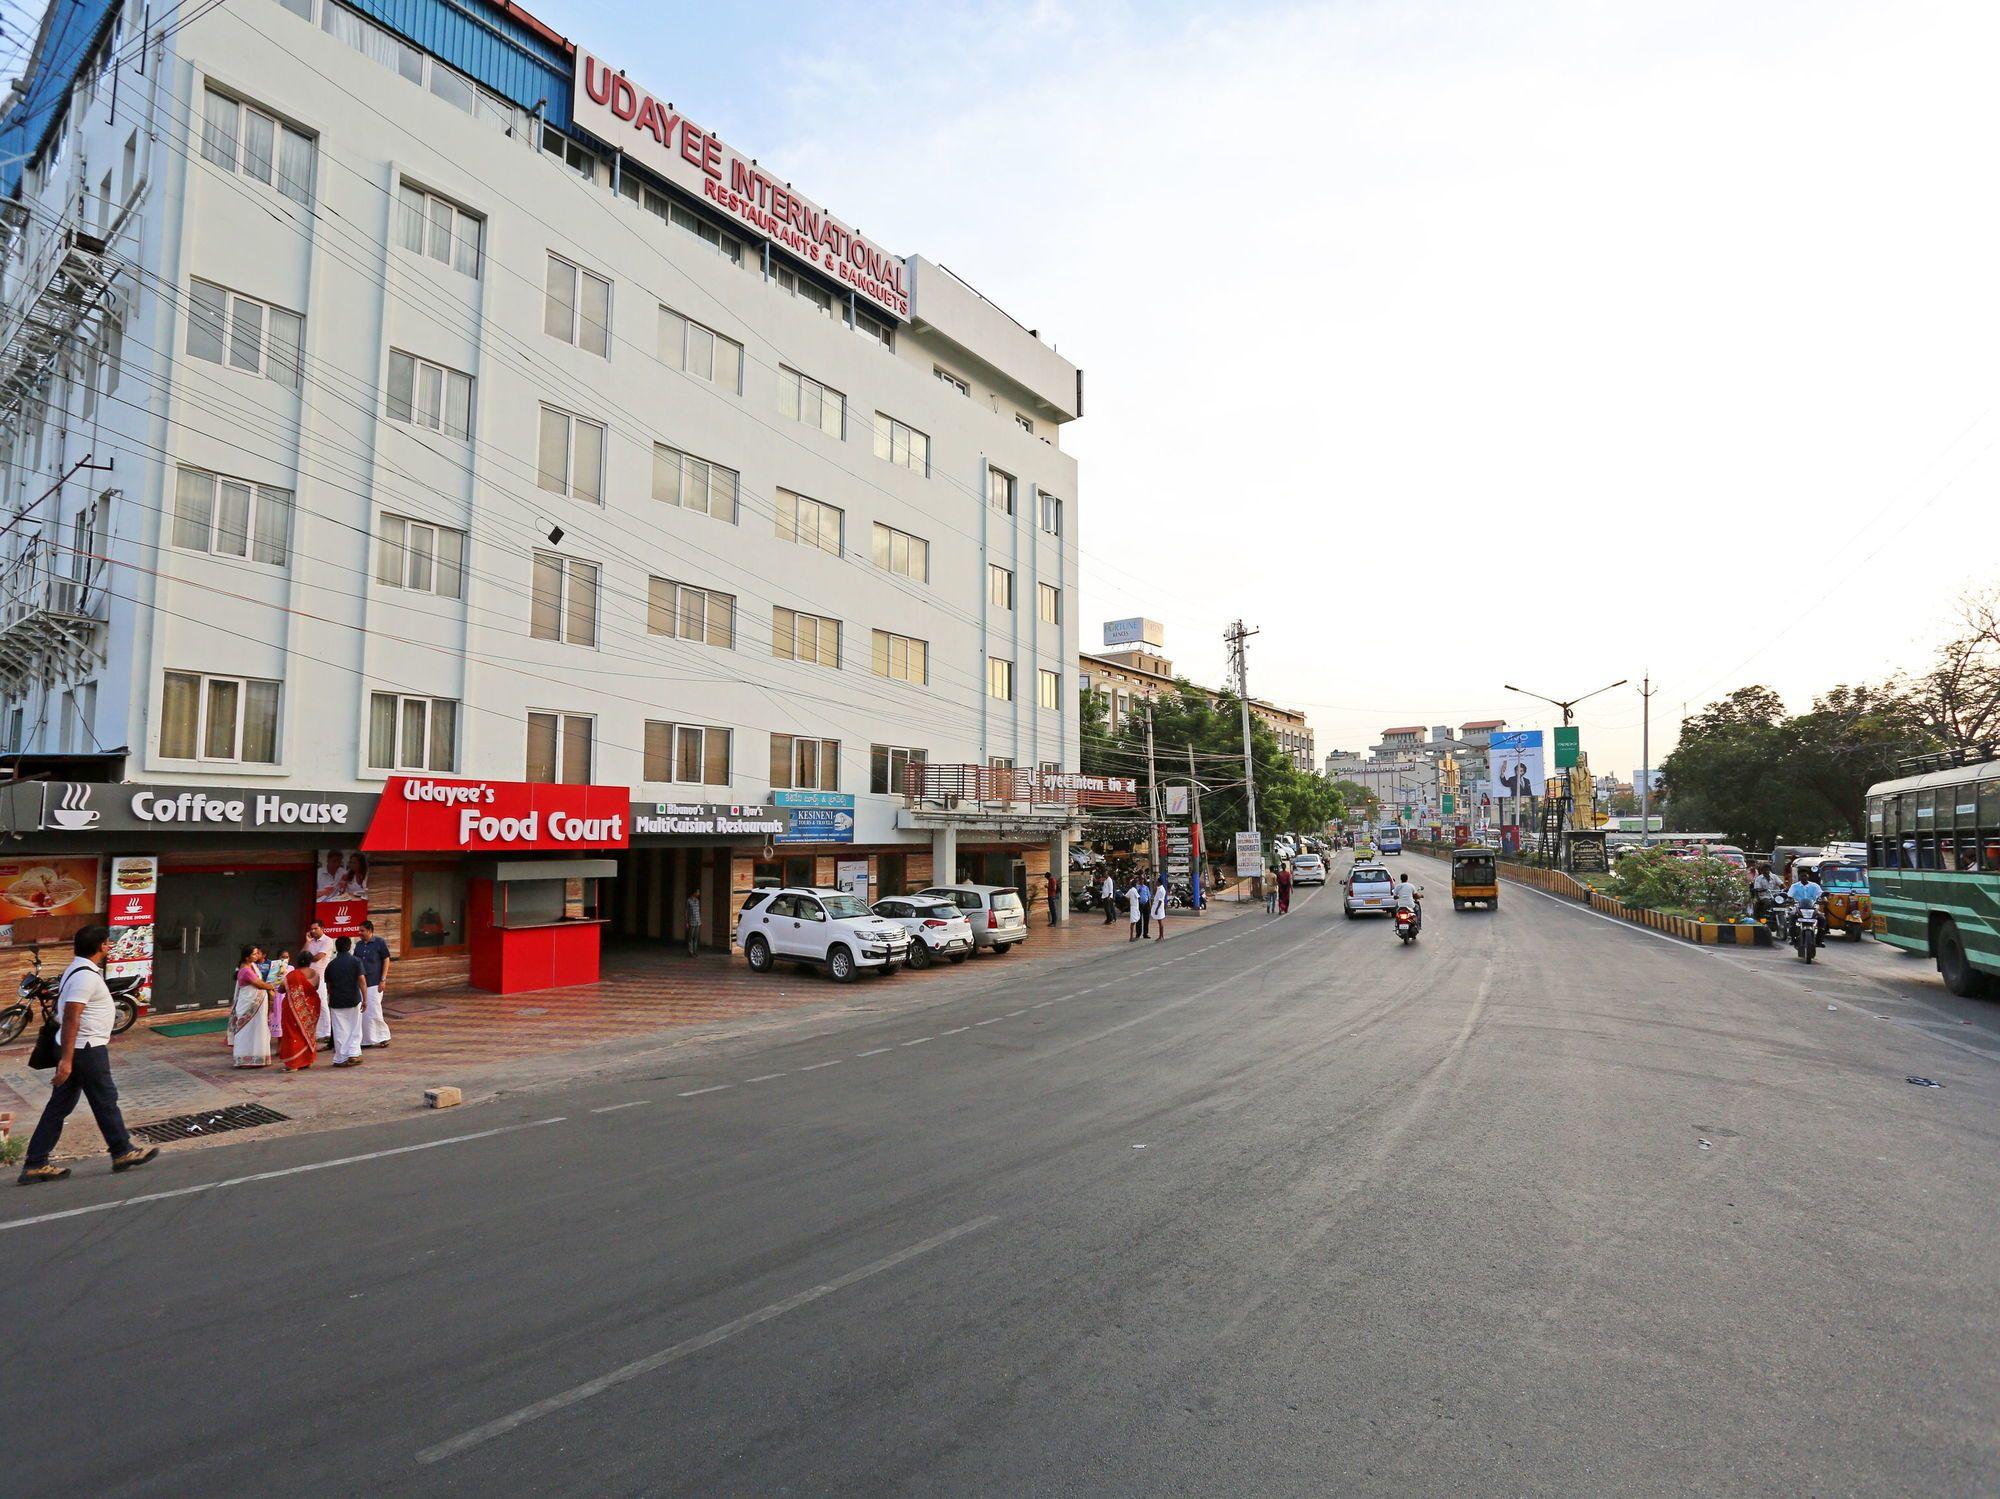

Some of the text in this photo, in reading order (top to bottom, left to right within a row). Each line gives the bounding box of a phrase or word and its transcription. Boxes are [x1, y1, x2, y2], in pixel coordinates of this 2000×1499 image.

[586, 55, 908, 298] UDAYEE INTERNATIONAL
[704, 177, 908, 315] RESTAURANTS & BANQUETS
[131, 791, 349, 826] Coffee House
[403, 780, 495, 807] Udayee's
[460, 809, 622, 845] Food Court
[635, 816, 783, 834] MultiCuisine Restaurants
[798, 810, 833, 820] KESINENI
